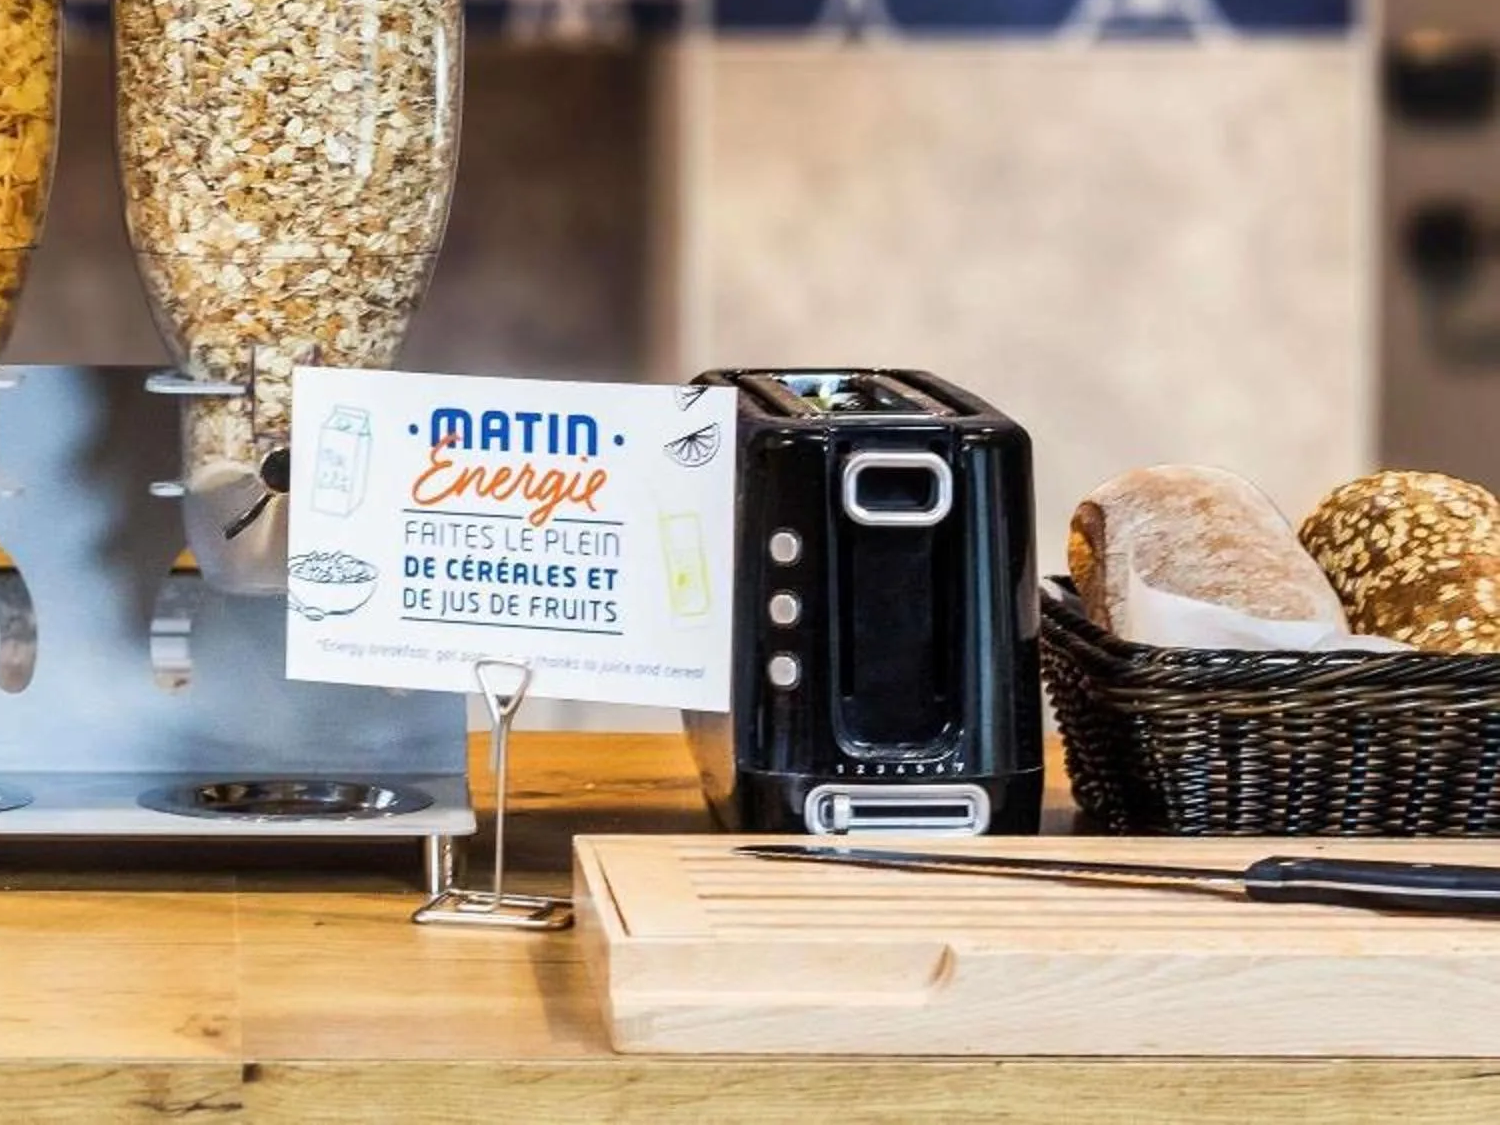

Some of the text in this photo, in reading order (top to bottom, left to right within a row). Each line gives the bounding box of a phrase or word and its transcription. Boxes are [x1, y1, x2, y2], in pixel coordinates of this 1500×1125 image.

[431, 408, 598, 456] MATIN
[404, 520, 620, 557] FAITES LE PLEIN
[404, 554, 619, 591] DE CÉRÉALES ET
[402, 587, 618, 623] DE JUS DE FRUITS
